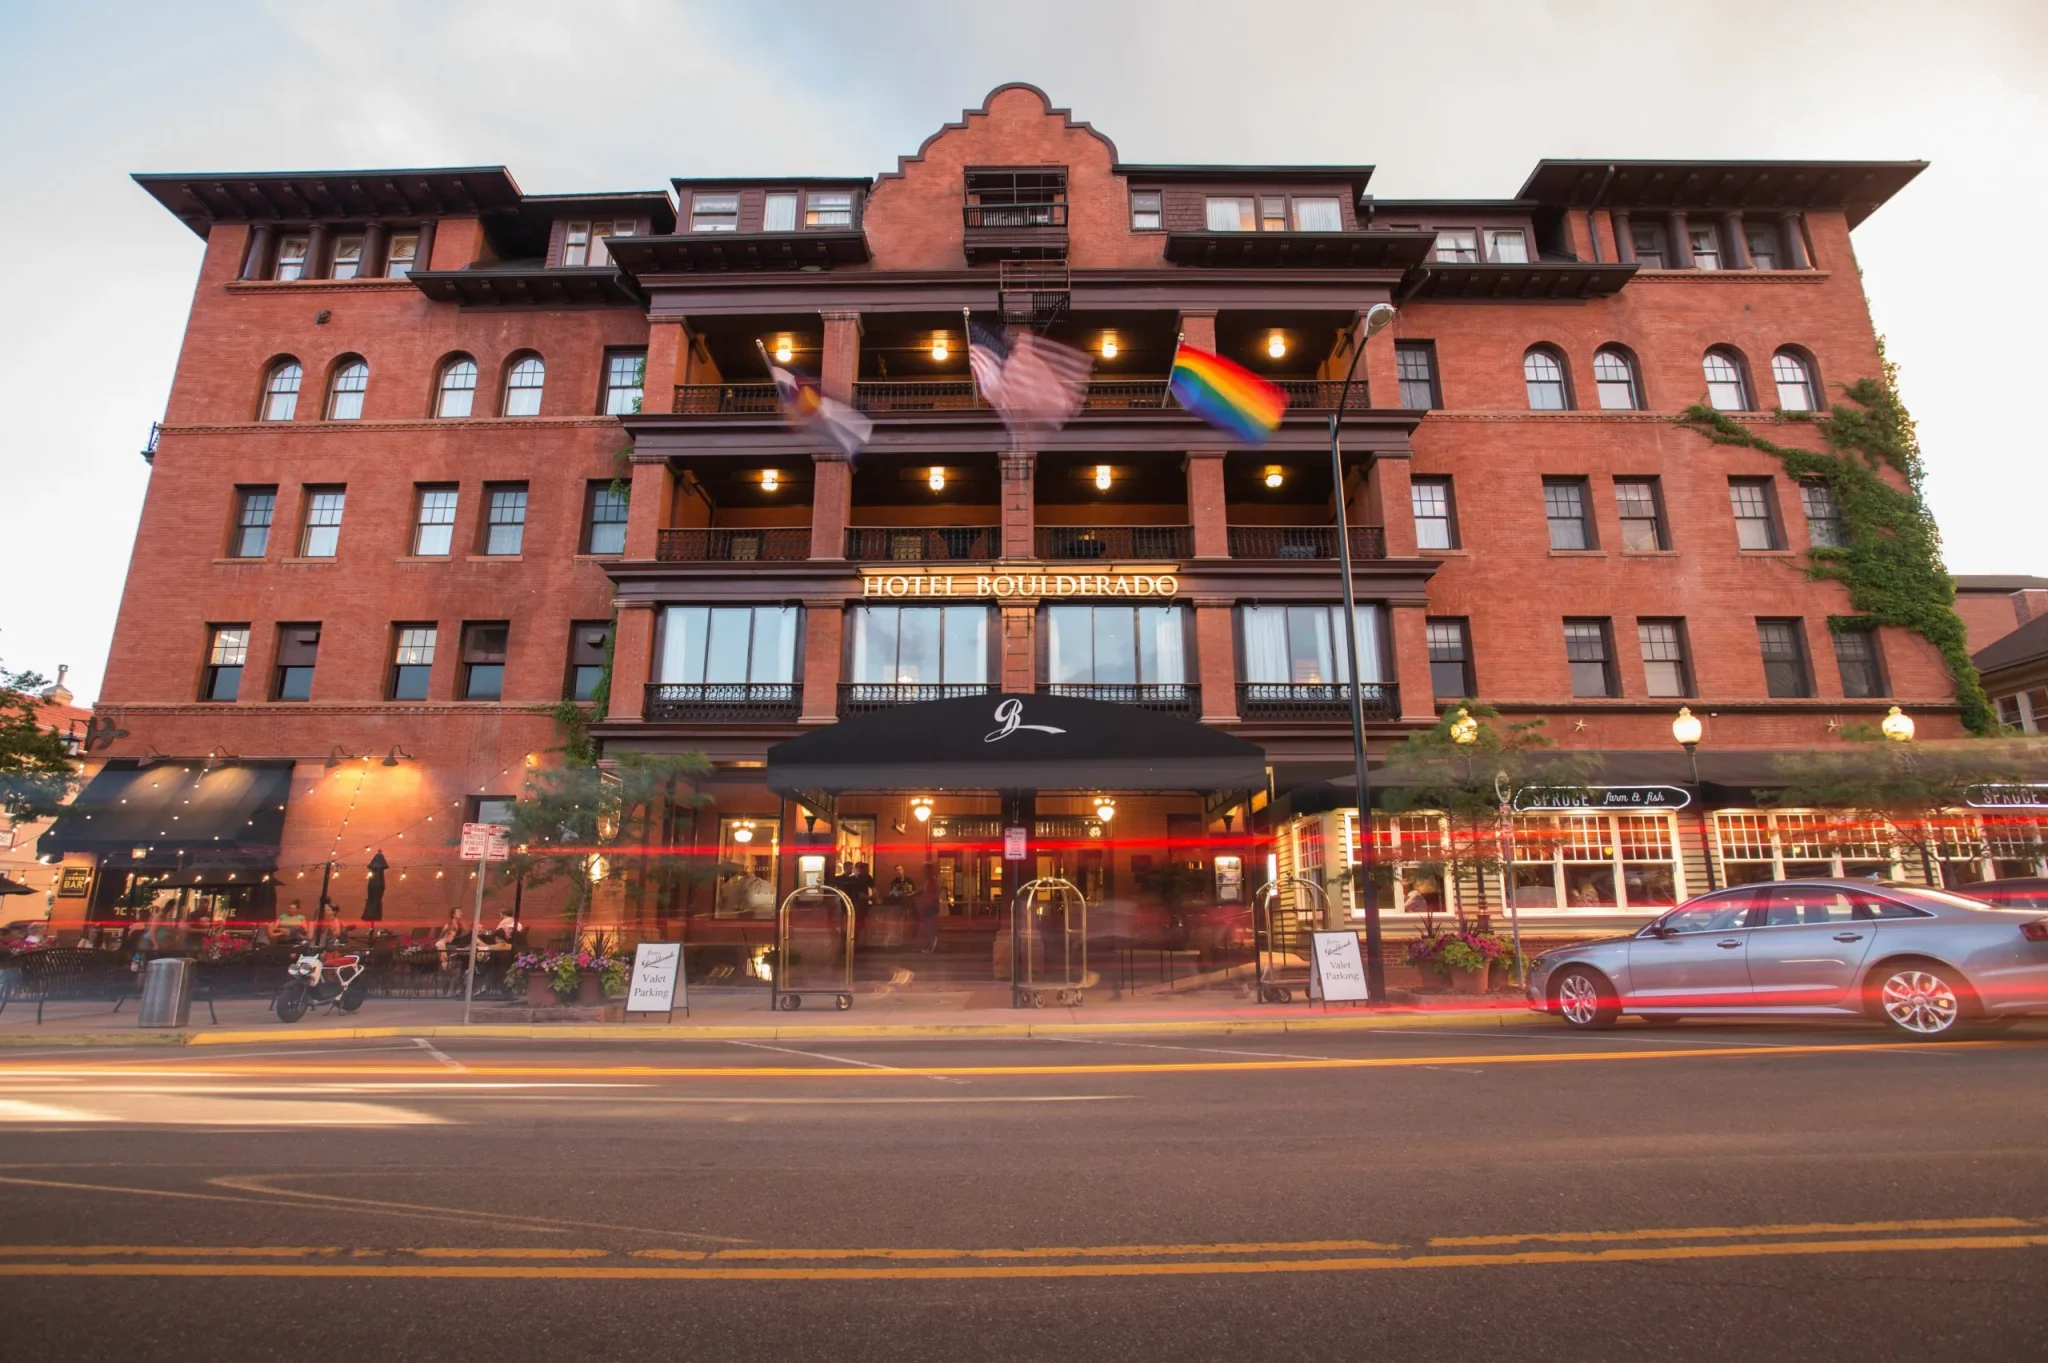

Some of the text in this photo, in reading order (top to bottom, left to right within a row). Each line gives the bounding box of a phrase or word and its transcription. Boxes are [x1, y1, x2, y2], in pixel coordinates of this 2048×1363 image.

[862, 574, 1179, 598] HOTEL BOULDERADO
[1603, 792, 1629, 805] farm
[1631, 792, 1641, 802] &
[1644, 791, 1665, 805] fish
[63, 880, 84, 889] BAR
[1330, 961, 1351, 969] Valet
[643, 974, 666, 984] Valet
[1326, 972, 1359, 981] Parking
[634, 987, 669, 999] Parking
